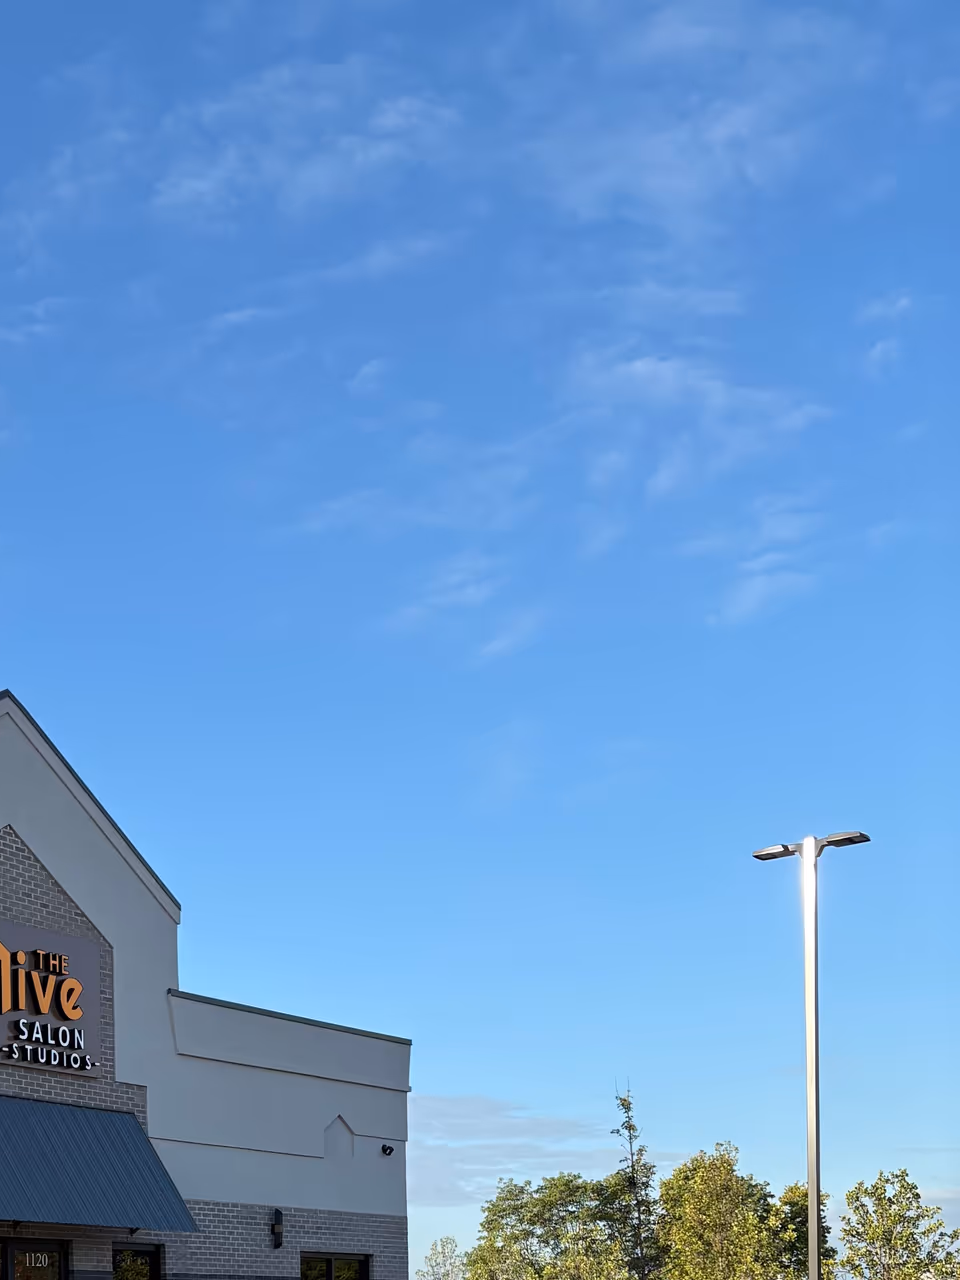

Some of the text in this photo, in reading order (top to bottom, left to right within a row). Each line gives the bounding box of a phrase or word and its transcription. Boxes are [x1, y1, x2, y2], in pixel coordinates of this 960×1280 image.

[37, 950, 69, 975] THE
[18, 1018, 84, 1050] SALON
[25, 1252, 49, 1267] 1120
